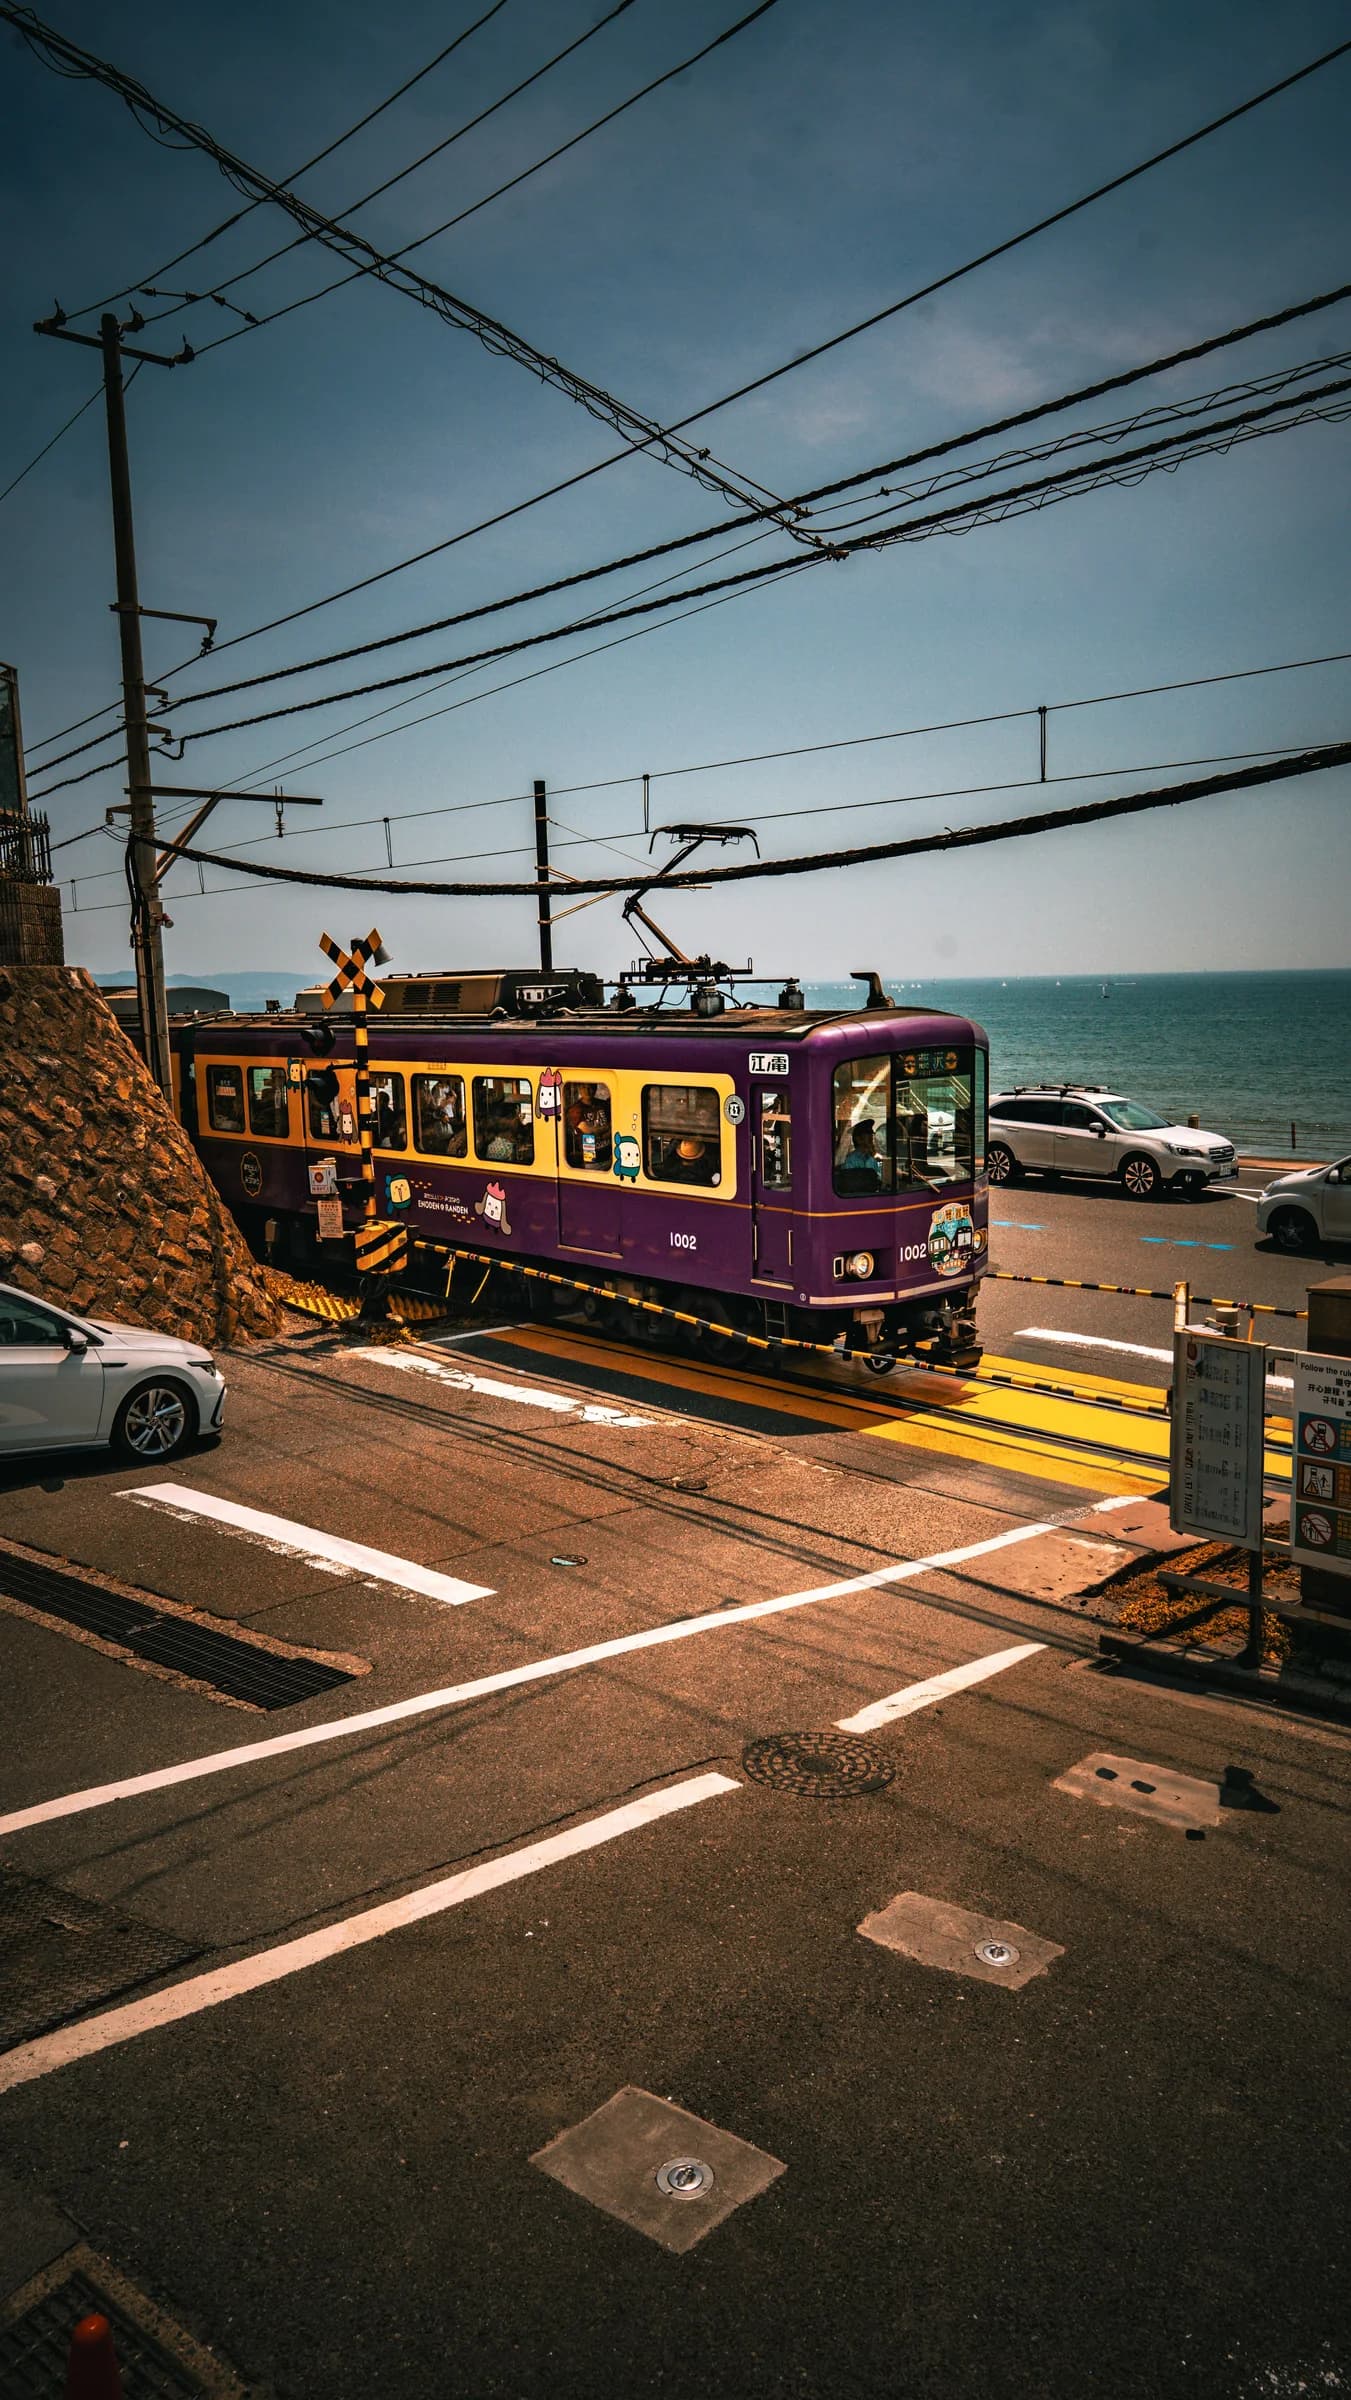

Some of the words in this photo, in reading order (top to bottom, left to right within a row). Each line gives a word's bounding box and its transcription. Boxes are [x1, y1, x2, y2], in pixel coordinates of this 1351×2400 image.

[751, 1055, 787, 1073] 江ノ電
[670, 1231, 697, 1250] 1002
[900, 1243, 927, 1263] 1002
[1300, 1361, 1324, 1373] Follow
[1326, 1366, 1338, 1375] the
